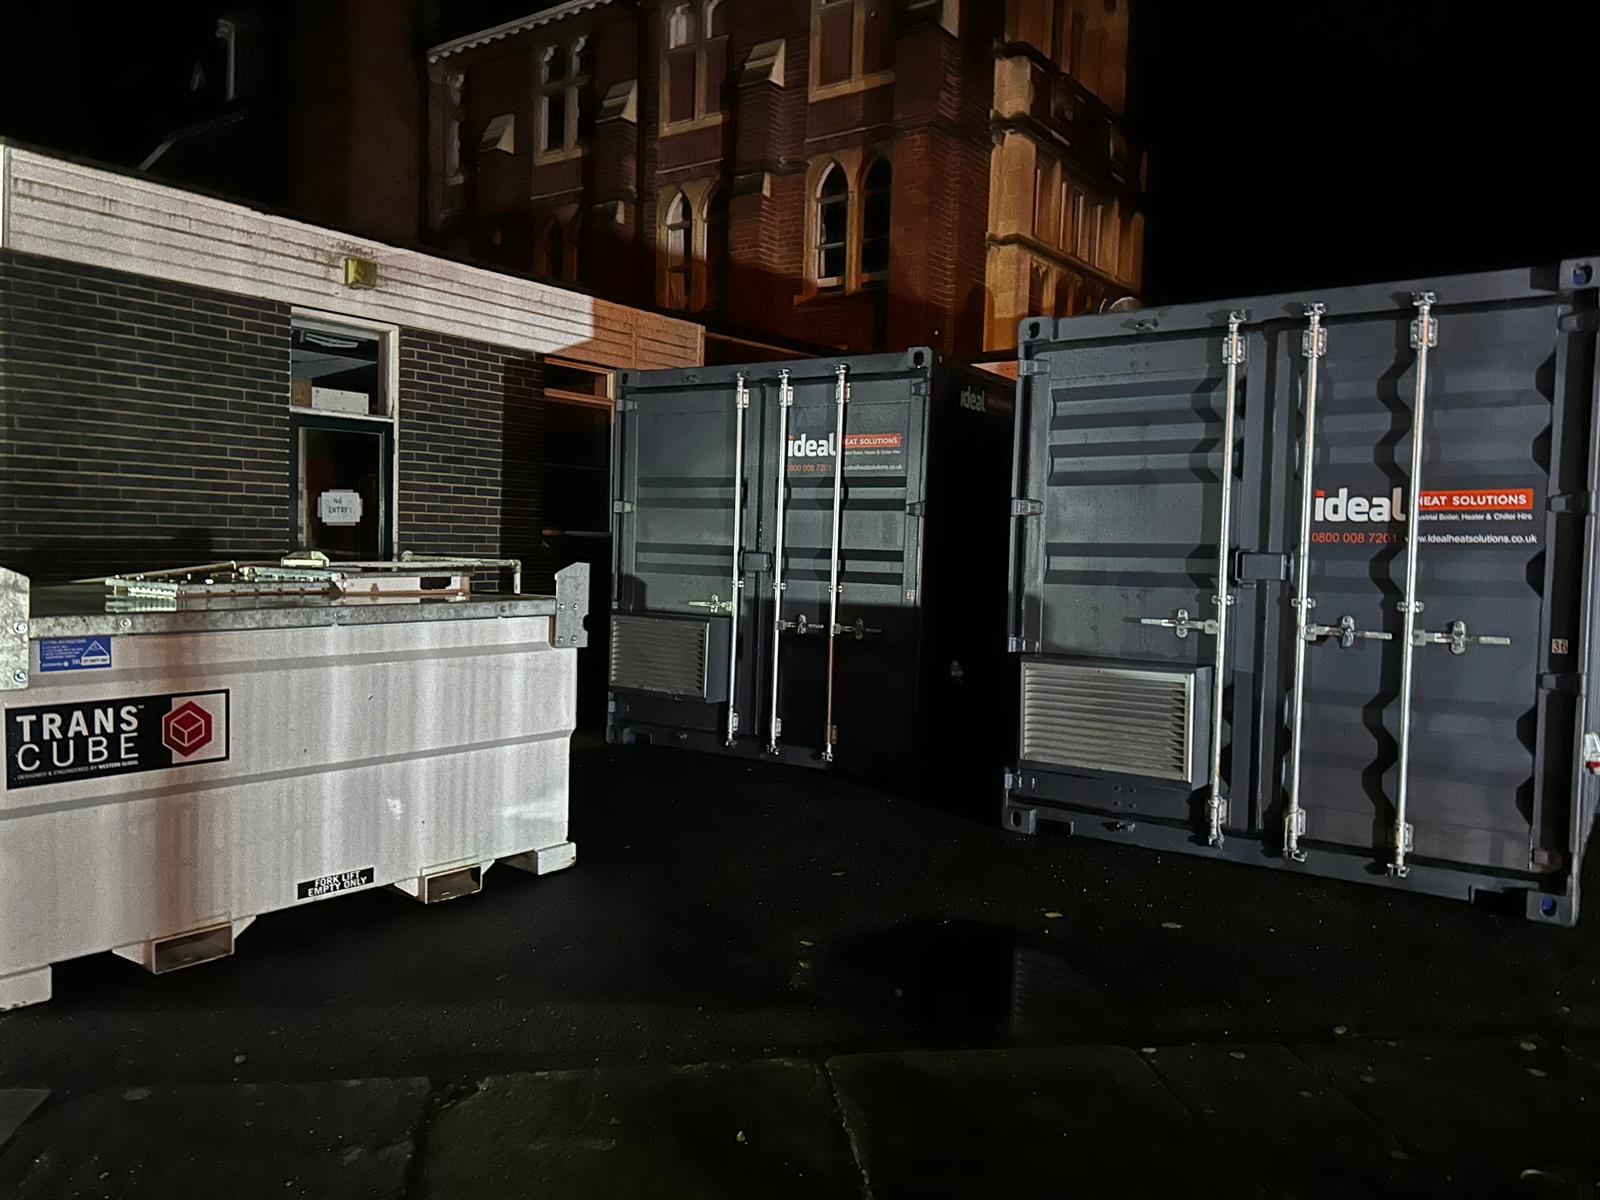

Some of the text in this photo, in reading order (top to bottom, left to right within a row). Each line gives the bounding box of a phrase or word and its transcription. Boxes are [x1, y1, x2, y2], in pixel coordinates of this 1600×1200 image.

[960, 385, 986, 413] ideal
[788, 432, 837, 457] ideal
[860, 437, 898, 445] SOLUTIONS
[1315, 487, 1406, 521] ideal
[1452, 494, 1527, 505] SOLUTIONS
[1486, 512, 1492, 520] &
[1312, 533, 1339, 543] 0800
[1343, 533, 1365, 543] 008
[1405, 534, 1537, 544] ww.idealheatsolutions.co.uk
[16, 705, 139, 742] TRANS
[17, 732, 139, 772] CUBE
[308, 876, 367, 897] EMPTY ONLY
[314, 871, 360, 888] FORK LIFT
